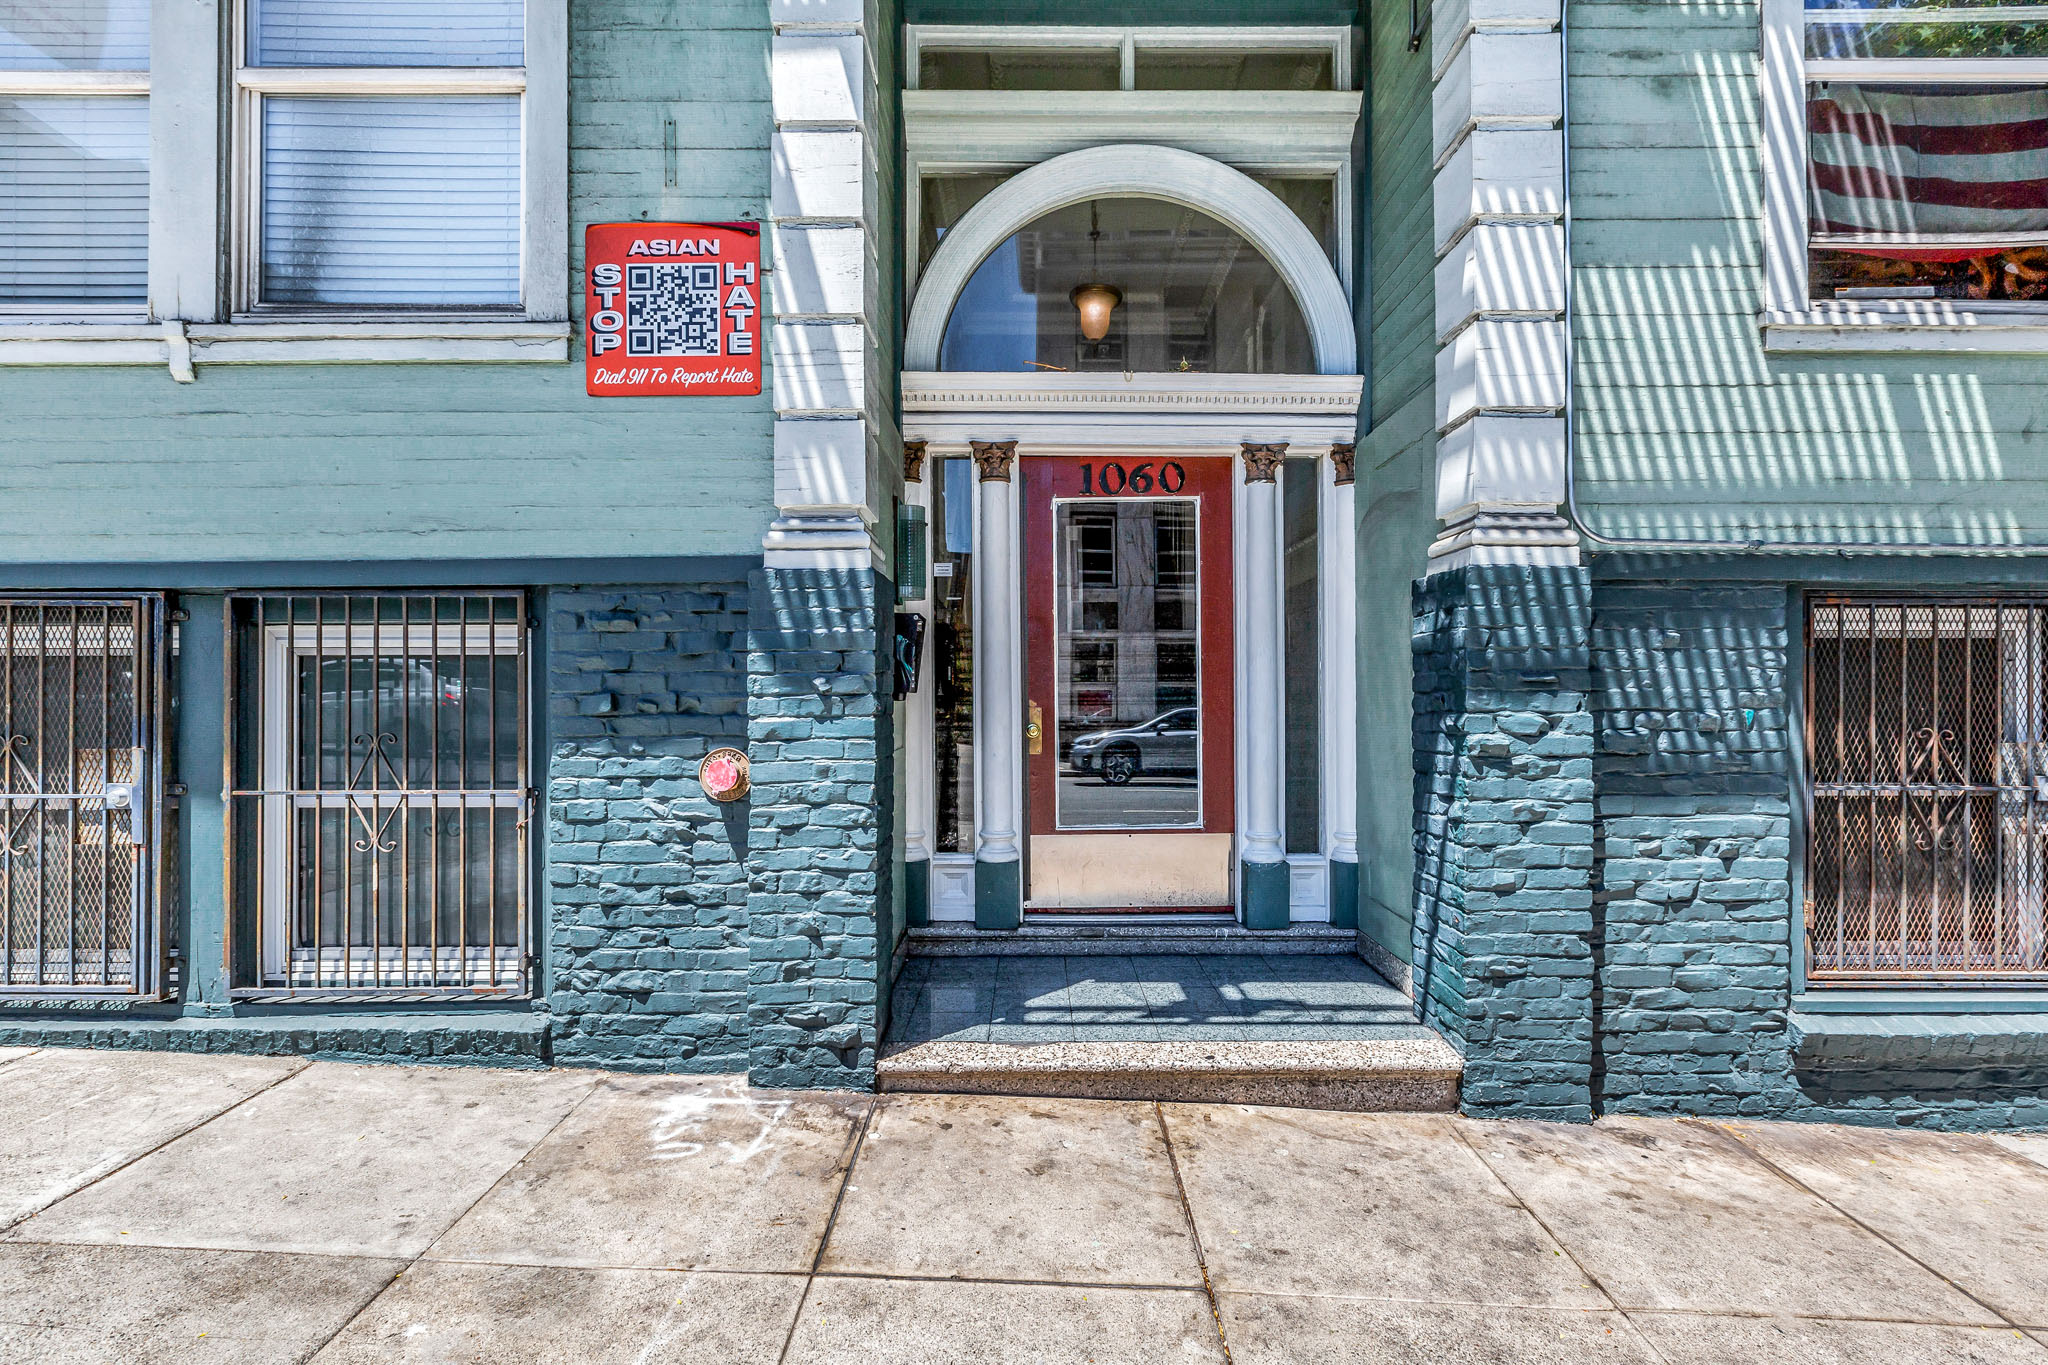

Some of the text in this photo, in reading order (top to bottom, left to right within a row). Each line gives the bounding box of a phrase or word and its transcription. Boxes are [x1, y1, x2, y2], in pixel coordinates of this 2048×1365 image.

[627, 239, 720, 257] ASIAN
[590, 263, 624, 357] STOP
[723, 262, 756, 355] HATE
[593, 366, 754, 388] Dial 911 To Report Hate
[1079, 462, 1186, 495] 1060
